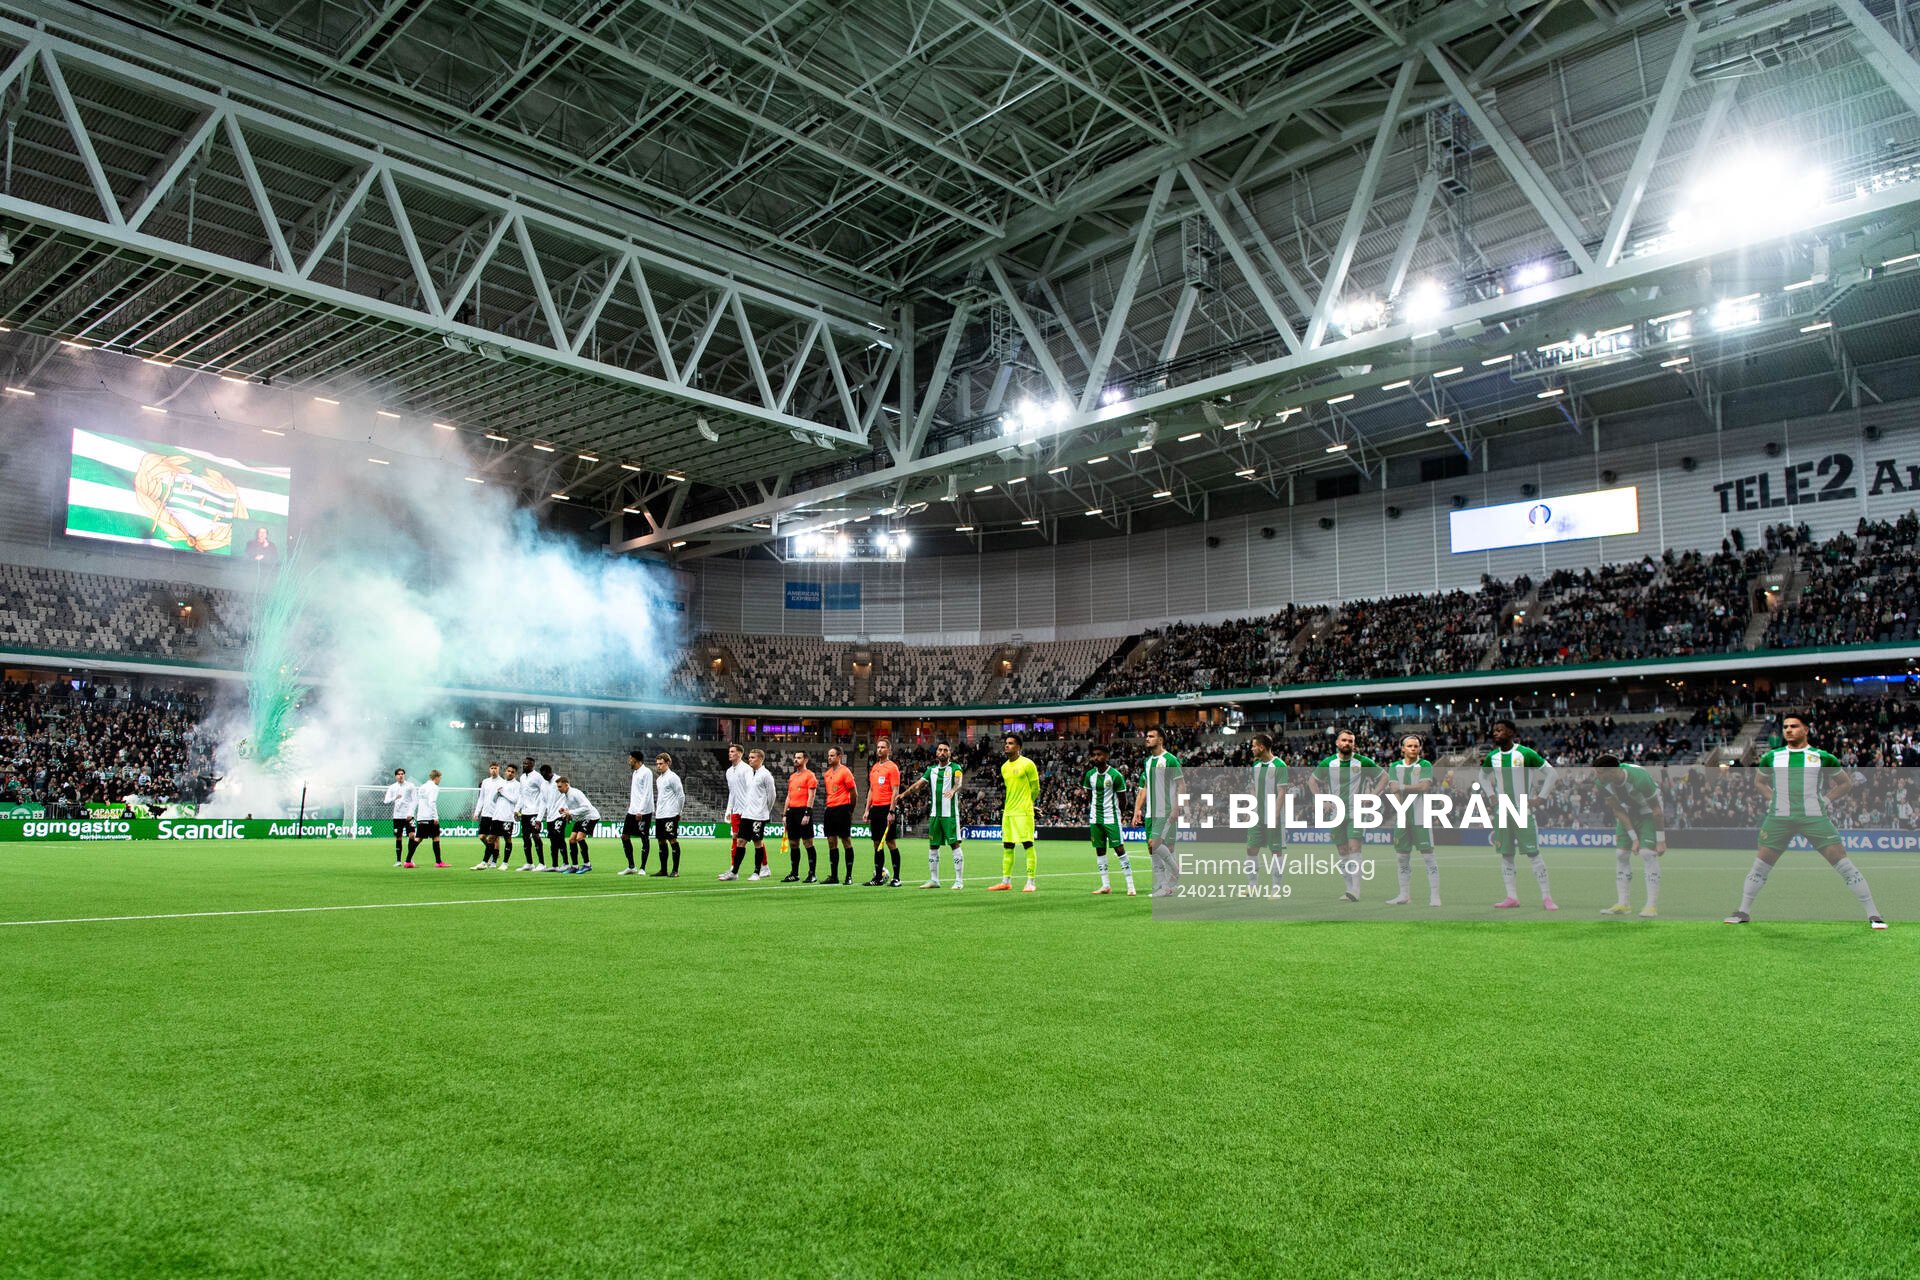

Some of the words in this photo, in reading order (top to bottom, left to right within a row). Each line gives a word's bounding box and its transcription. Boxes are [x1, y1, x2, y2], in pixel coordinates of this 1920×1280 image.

[1713, 454, 1857, 513] TELE2
[158, 820, 245, 840] Scandic
[268, 822, 373, 838] AudicomPendax
[971, 830, 1003, 839] SVENSK
[1877, 836, 1920, 849] CUP
